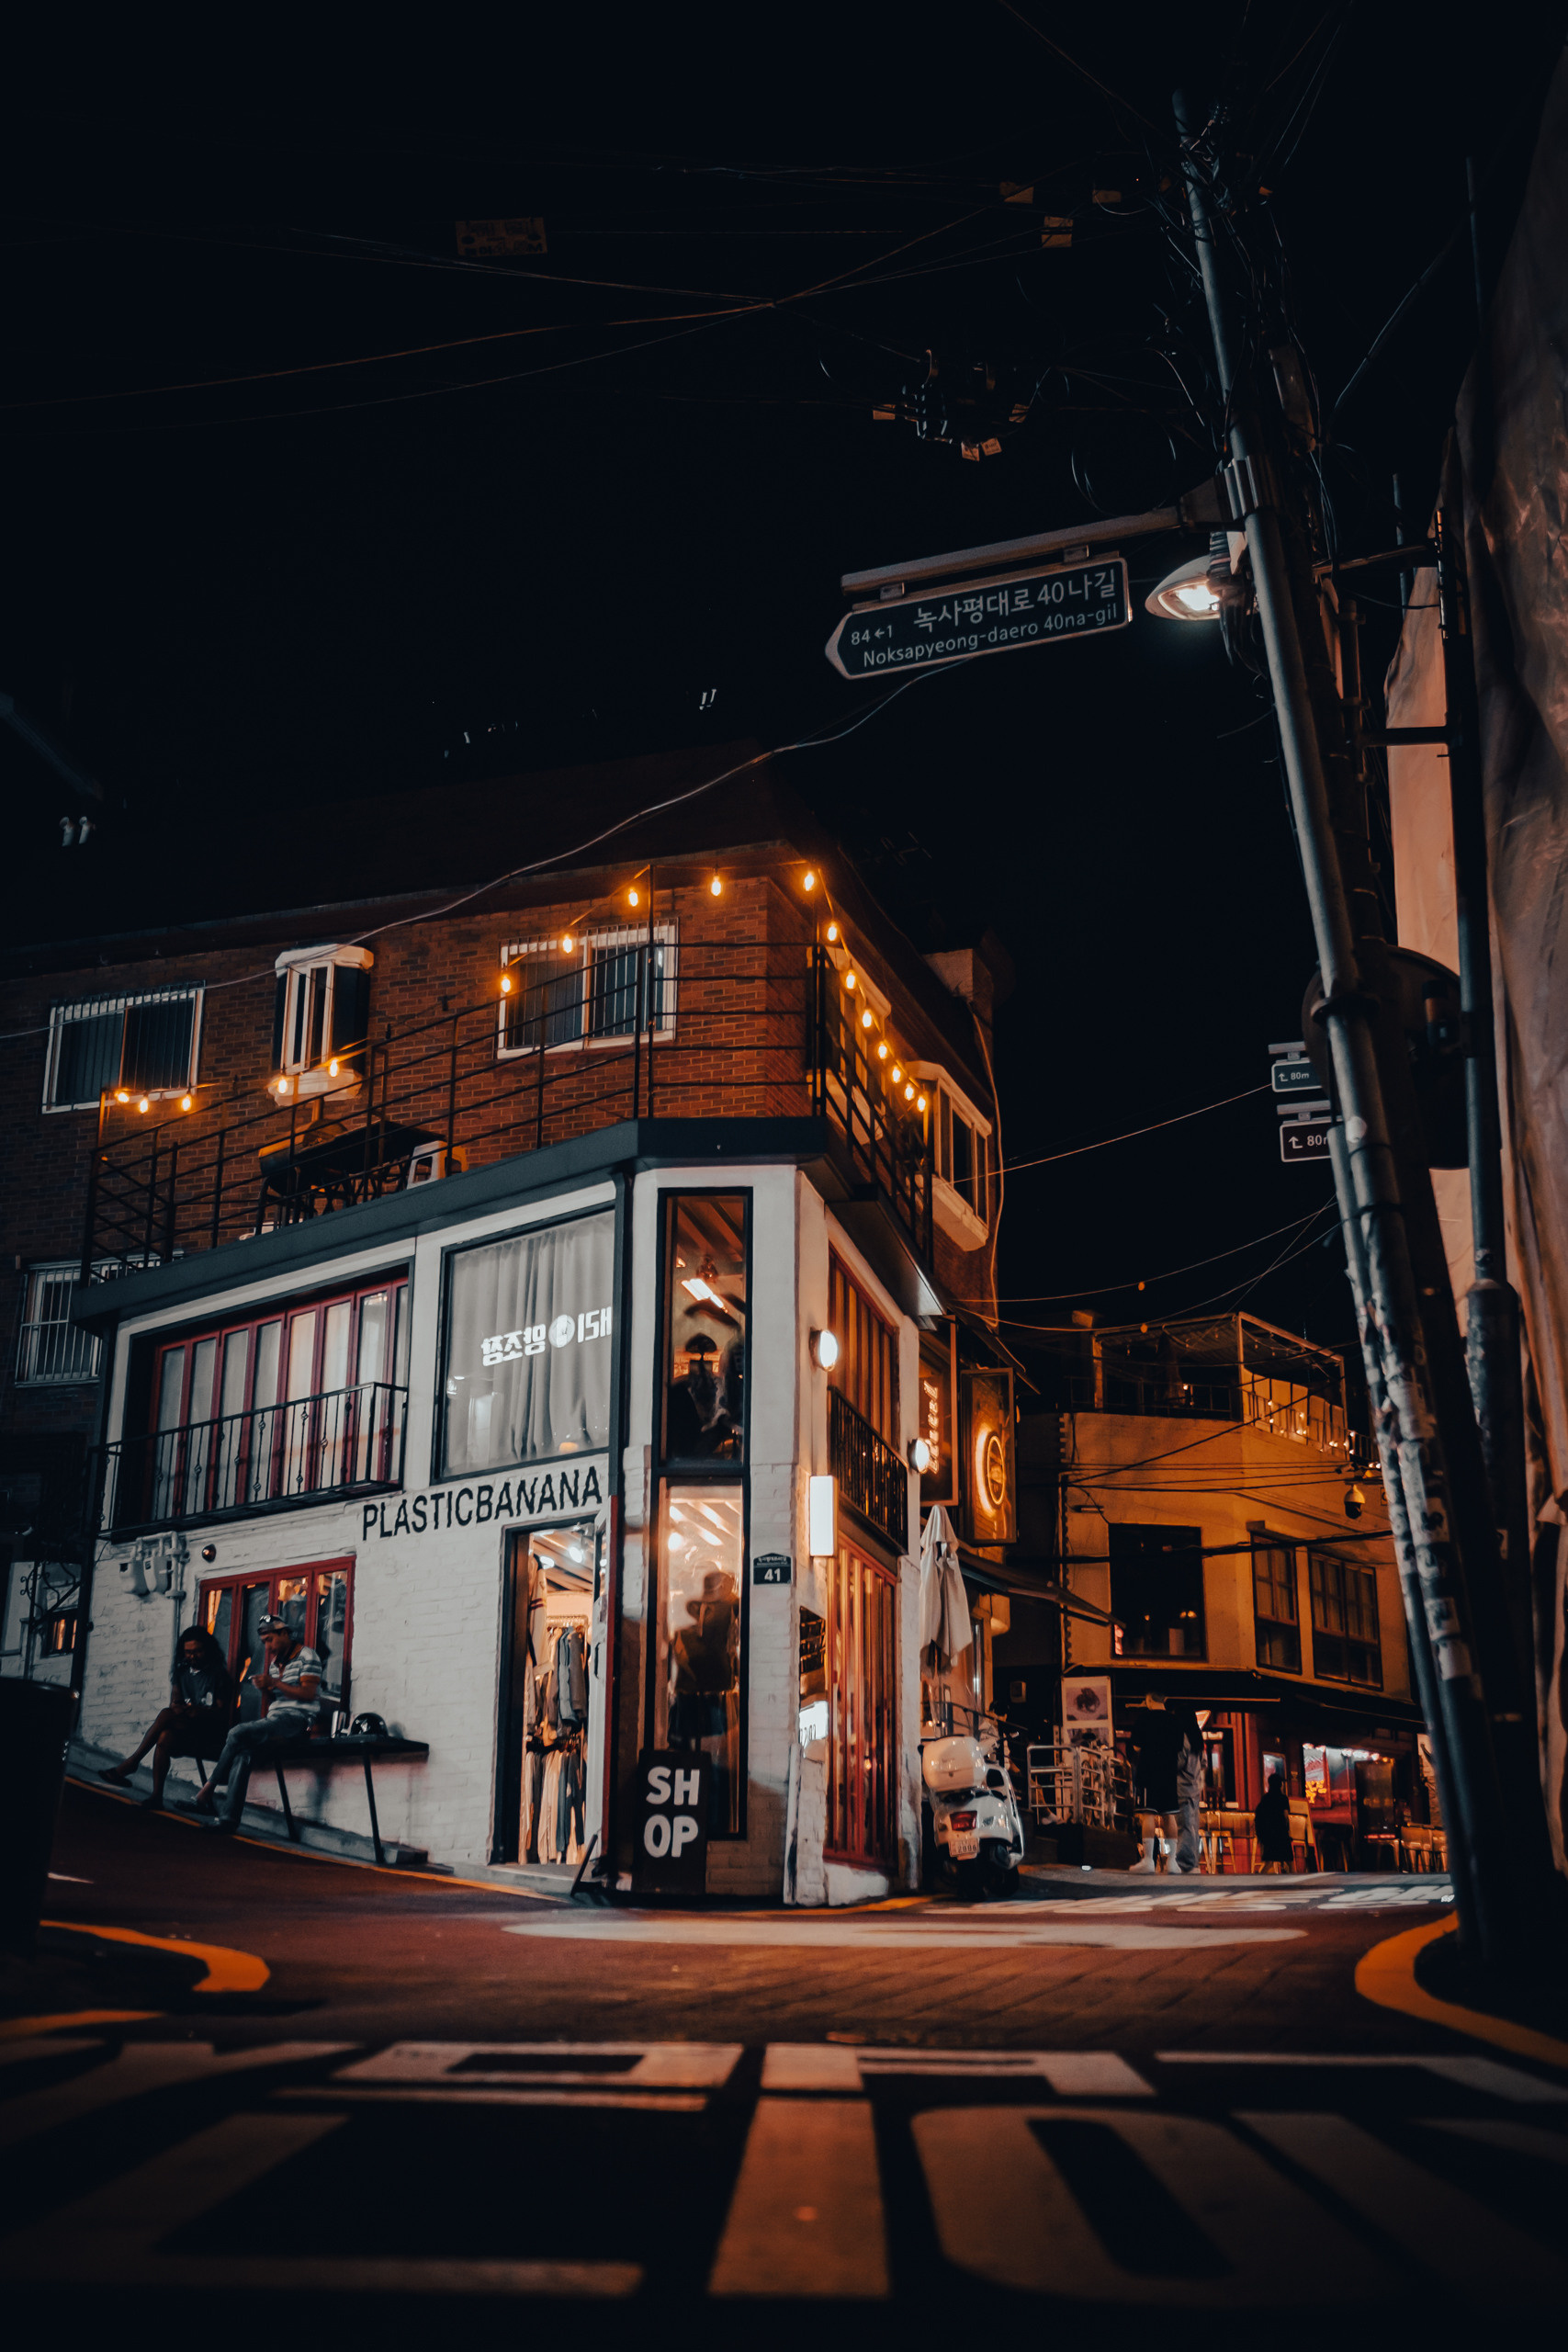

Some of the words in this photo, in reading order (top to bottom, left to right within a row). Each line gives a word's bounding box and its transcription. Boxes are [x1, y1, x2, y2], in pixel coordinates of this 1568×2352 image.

[914, 569, 1117, 633] 녹사평대로40나길
[851, 629, 871, 646] 84
[863, 622, 1039, 668] Noksapyeong-daero
[1043, 604, 1118, 631] 40na-gil
[1290, 1072, 1310, 1080] 80m
[363, 1465, 603, 1542] PLASTICBANANA
[764, 1568, 781, 1582] 41
[646, 1766, 700, 1805] SH
[643, 1815, 699, 1858] OP
